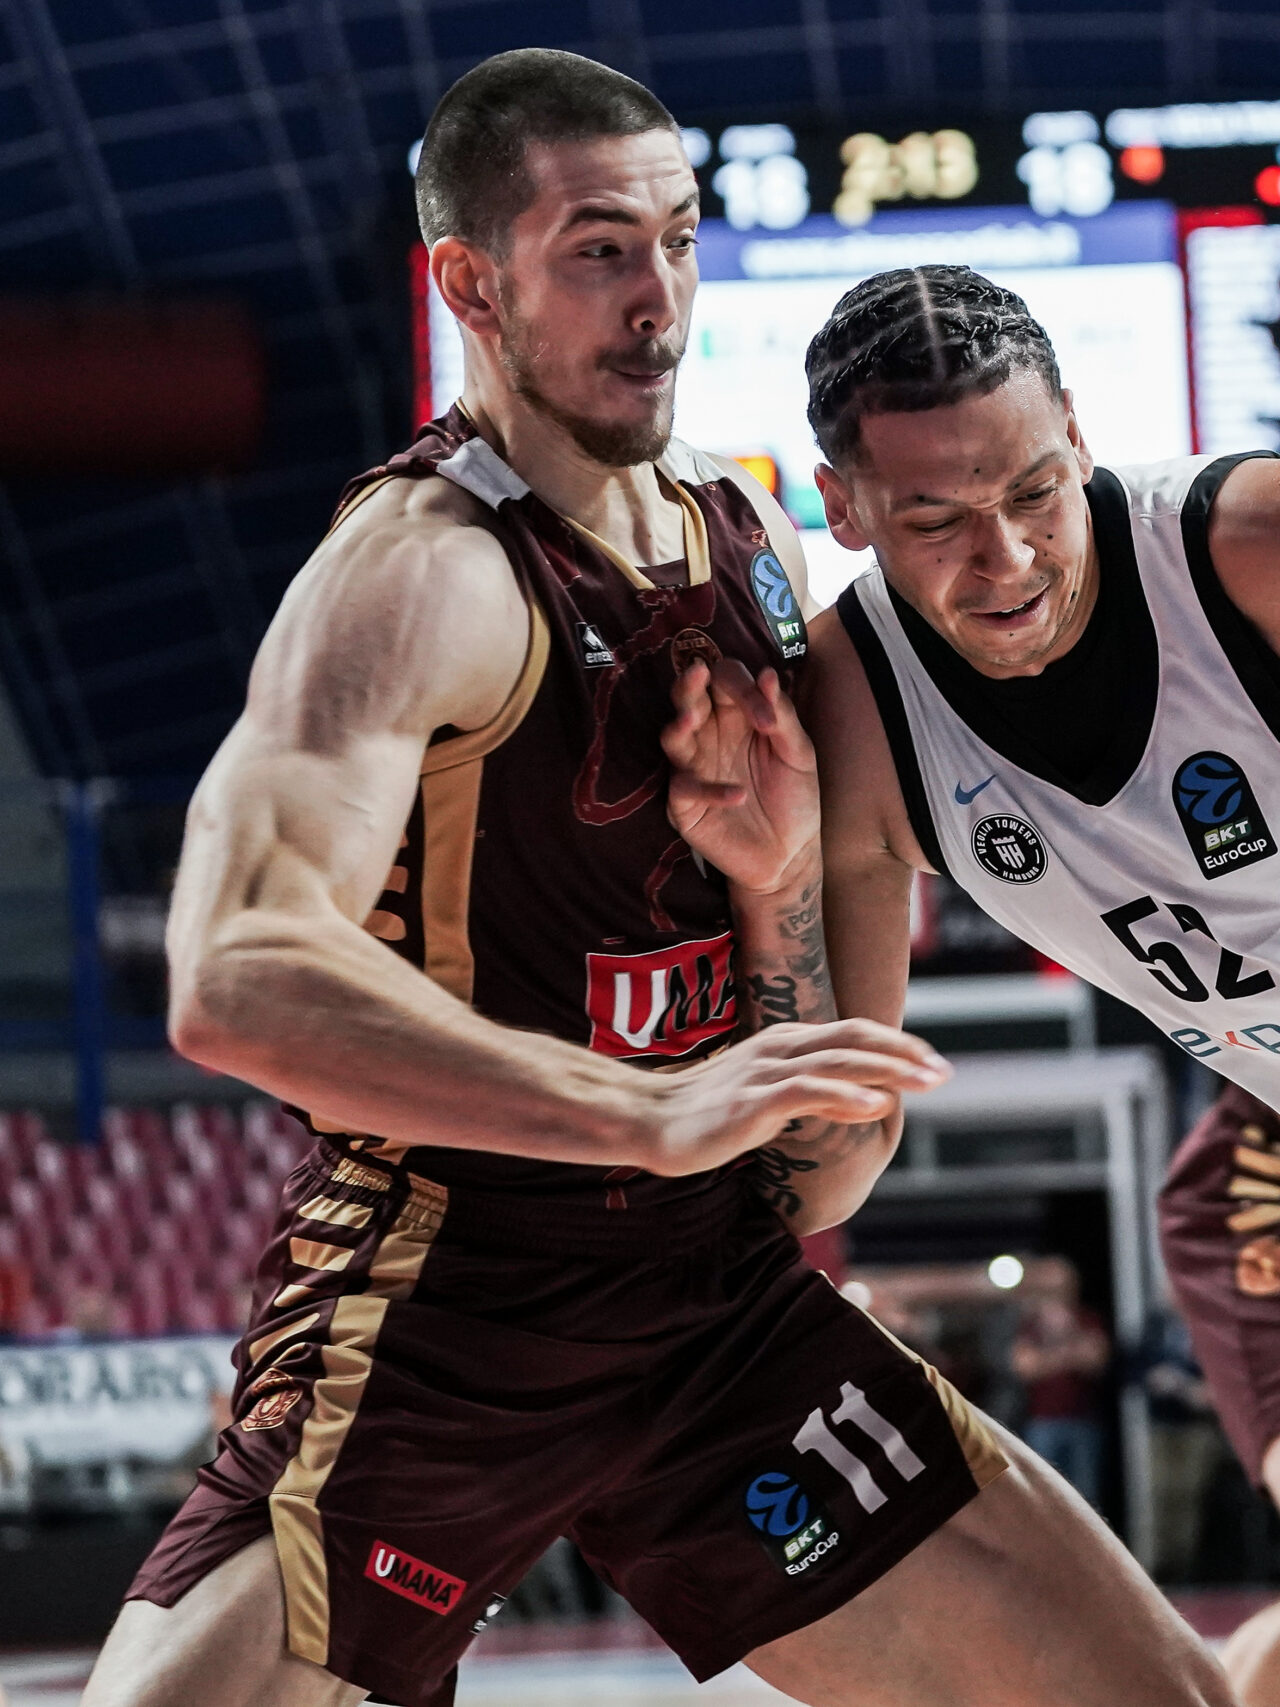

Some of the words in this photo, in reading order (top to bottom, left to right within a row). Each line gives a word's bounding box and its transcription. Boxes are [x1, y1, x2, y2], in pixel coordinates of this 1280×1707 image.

[777, 621, 800, 640] BKT
[976, 822, 993, 855] VEOLIA
[994, 819, 1037, 846] TOWERS
[1203, 837, 1268, 870] EuroCup
[1204, 820, 1250, 852] BKT
[1002, 866, 1040, 881] HAMBURG
[1099, 895, 1276, 1003] 52
[791, 1380, 928, 1515] 11
[785, 1519, 823, 1561] BKT
[785, 1532, 840, 1576] EuroCup
[374, 1548, 455, 1608] UMANA
